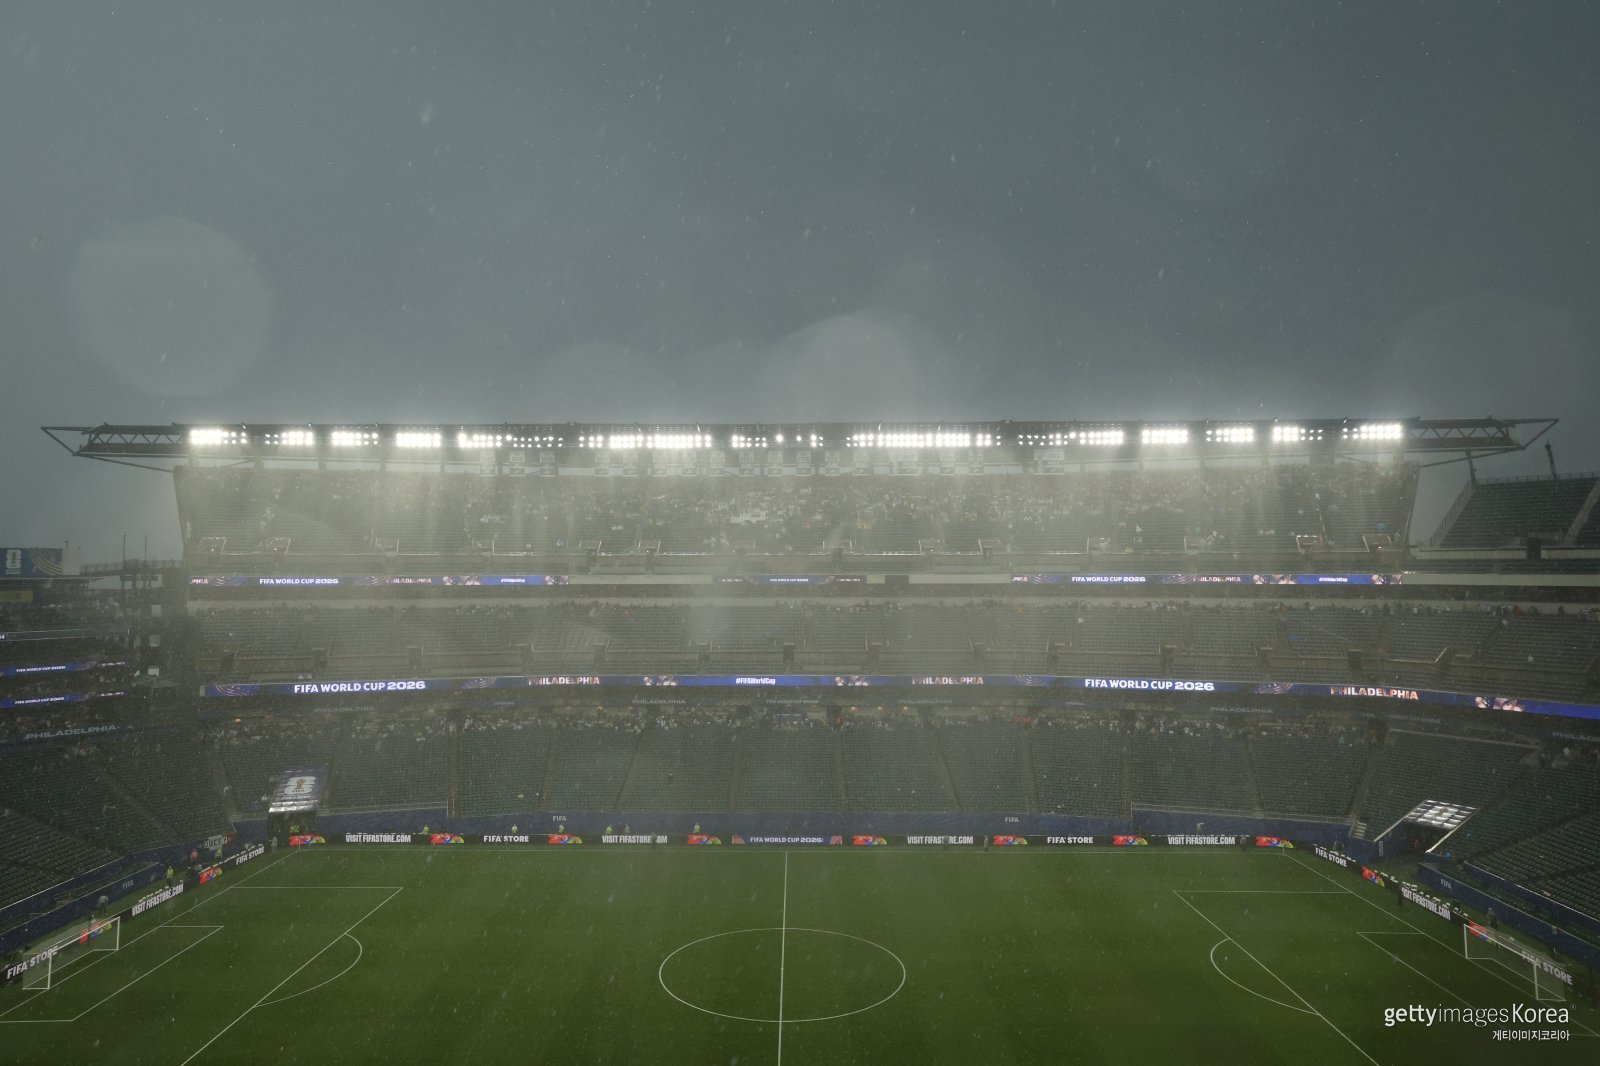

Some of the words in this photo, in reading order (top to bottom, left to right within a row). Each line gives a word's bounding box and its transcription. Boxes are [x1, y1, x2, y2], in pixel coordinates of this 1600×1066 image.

[294, 684, 319, 694] FIFA
[321, 683, 361, 693] WORLD
[363, 682, 386, 691] CUP
[387, 681, 426, 690] 2026
[1085, 679, 1108, 688] FIFA
[1109, 679, 1149, 689] WORLD
[1150, 680, 1173, 690] CUP
[1174, 682, 1215, 691] 2026
[1330, 686, 1419, 700] PHILADELPHIA
[25, 725, 116, 740] PHILADELPHIA
[346, 834, 362, 843] VISIT
[363, 834, 411, 843] FIFASTORE.COM
[484, 835, 501, 843] FIFA
[504, 835, 529, 843] STORE
[602, 835, 618, 844] VISIT
[907, 836, 924, 845] VISIT
[925, 836, 974, 845] FIFASTRE.COM
[1168, 836, 1185, 845] VISIT
[1185, 836, 1236, 845] FIFASTORE.COM
[235, 855, 249, 866] FIFA
[249, 846, 265, 858] STORE
[1315, 847, 1329, 859] FIFA
[1328, 853, 1348, 868] STORE
[122, 879, 134, 890] FIFA
[1440, 878, 1452, 889] FIFA
[7, 963, 28, 979] FIFA
[30, 945, 59, 967] STORE
[1542, 961, 1573, 986] STORE
